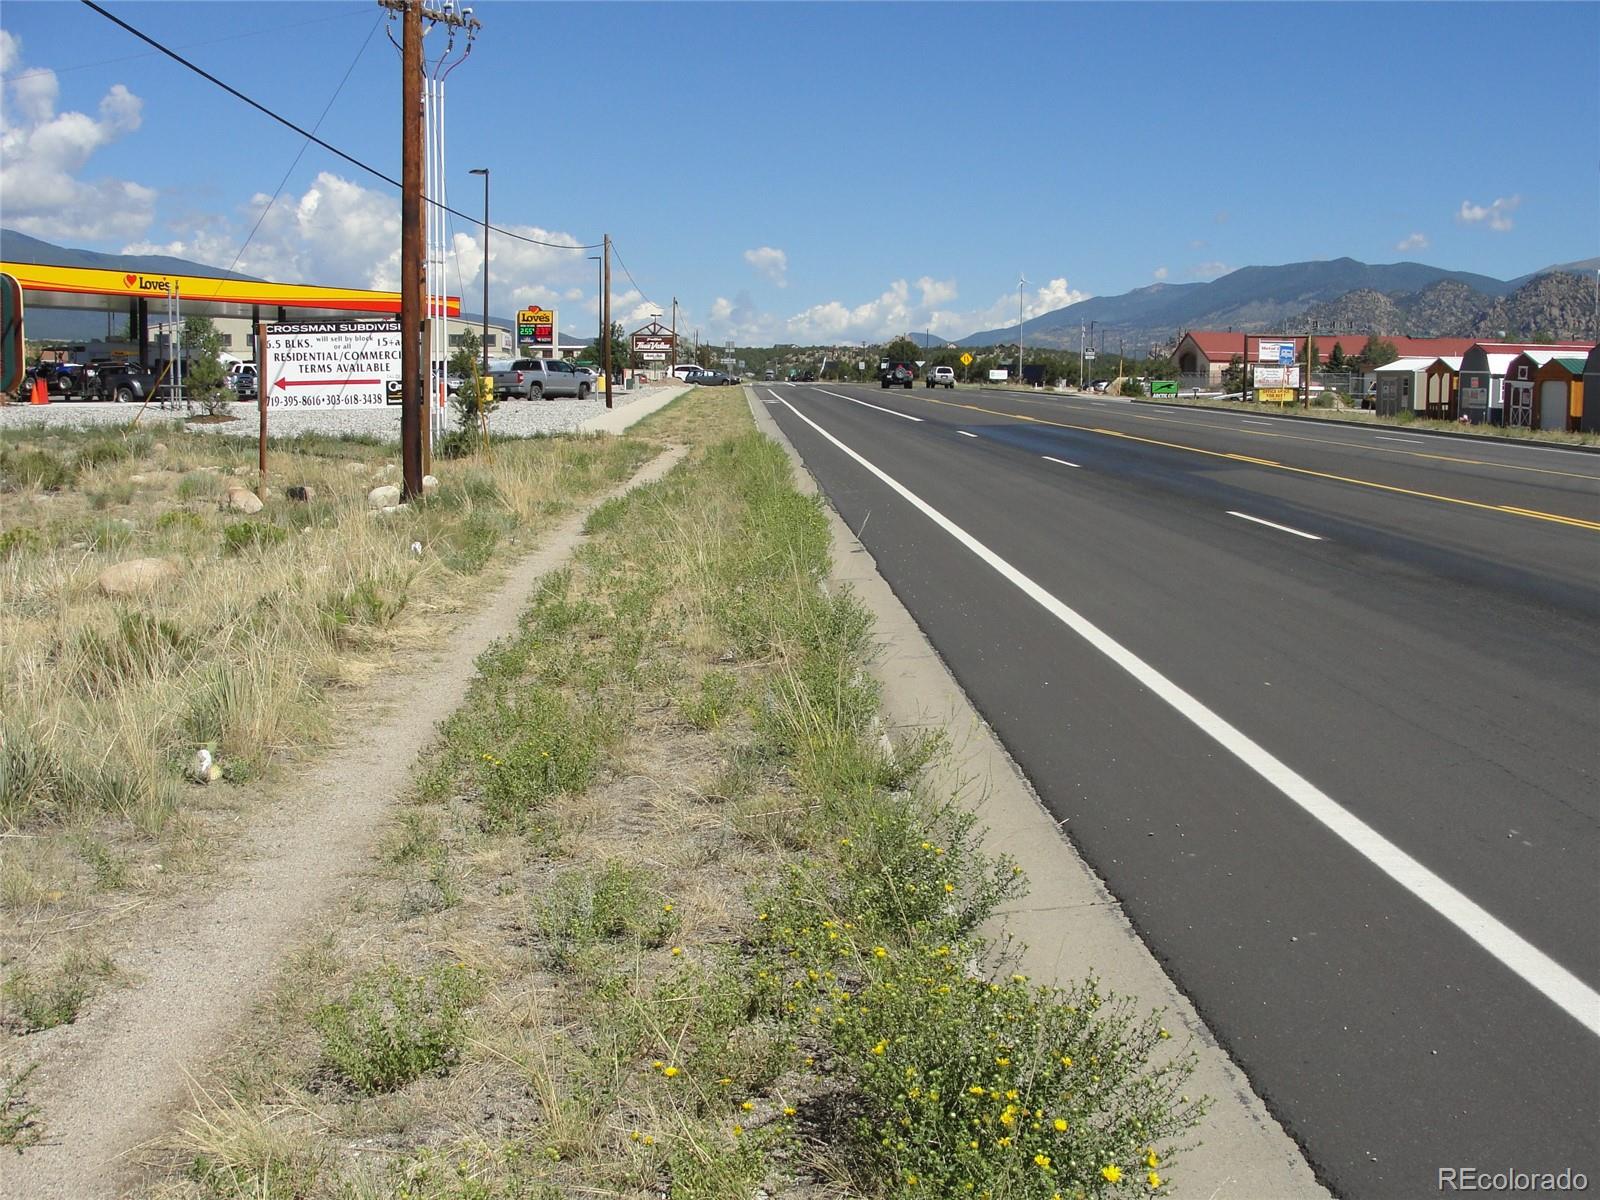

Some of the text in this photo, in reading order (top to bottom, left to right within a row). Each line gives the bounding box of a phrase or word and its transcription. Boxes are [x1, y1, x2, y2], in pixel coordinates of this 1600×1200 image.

[139, 277, 170, 291] Love's
[521, 313, 550, 322] Love's
[266, 324, 336, 333] CROSSMAN
[285, 339, 313, 349] BLKS.
[299, 363, 391, 373] TERMS AVAILABLE
